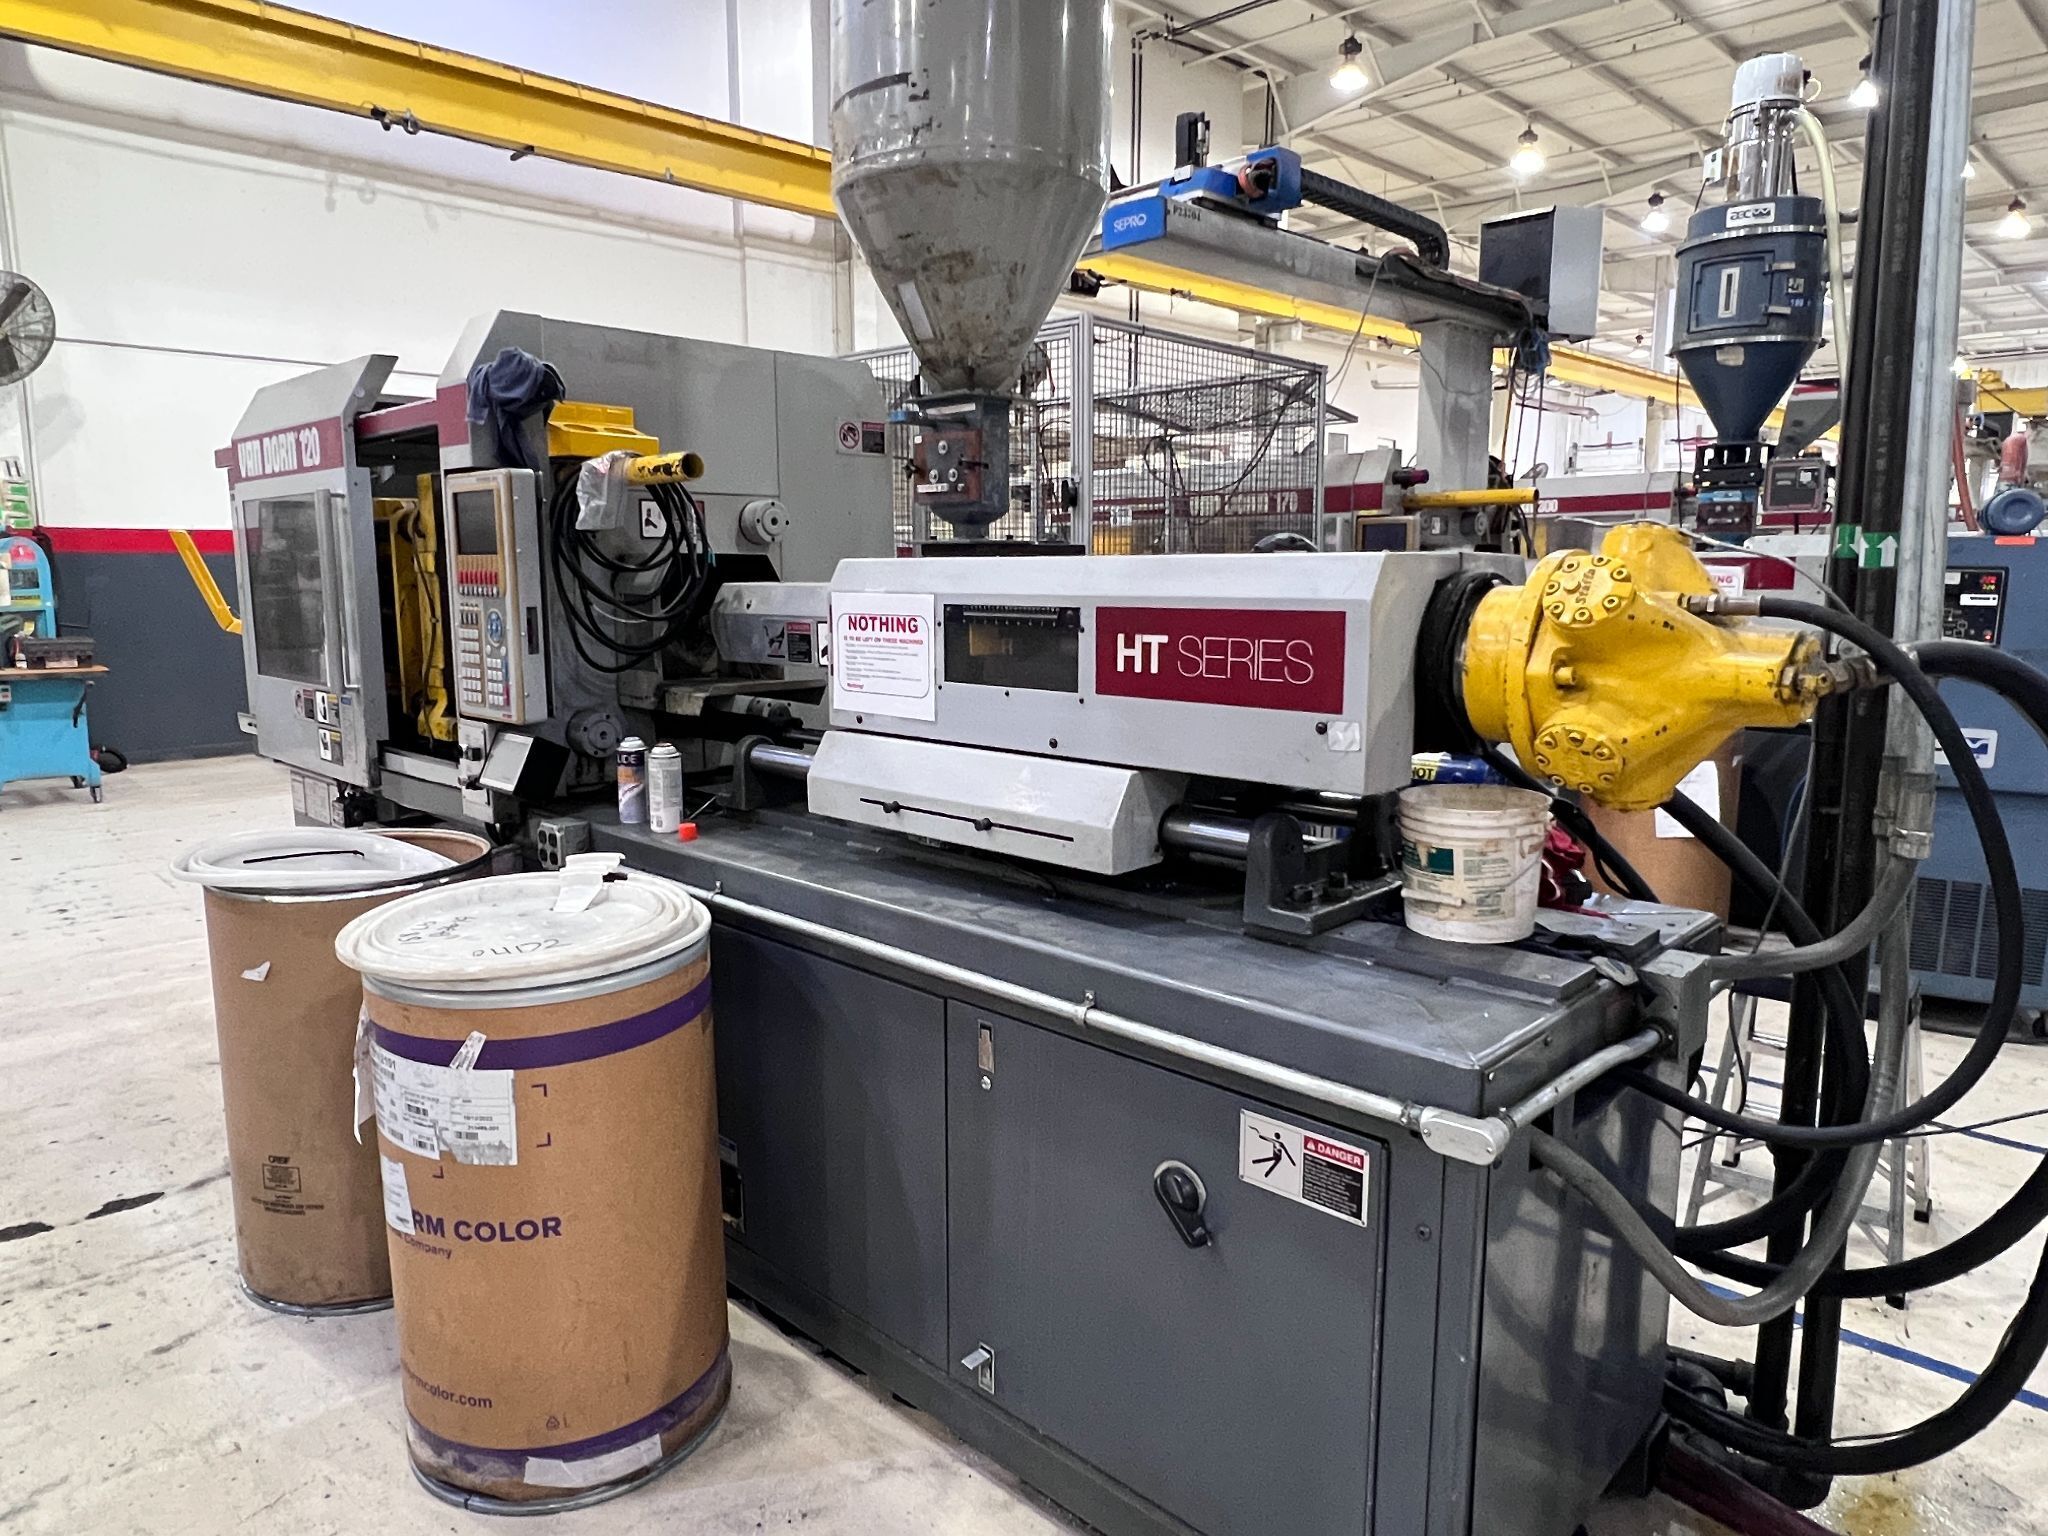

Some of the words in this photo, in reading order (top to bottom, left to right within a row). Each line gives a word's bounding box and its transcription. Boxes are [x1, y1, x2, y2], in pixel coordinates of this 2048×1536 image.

[1113, 213, 1147, 233] SEPRO
[237, 439, 263, 479] VAN
[262, 430, 298, 475] DORN
[298, 426, 320, 468] 120
[1537, 499, 1559, 513] 200
[847, 615, 919, 634] NOTHING
[1116, 633, 1169, 674] HT
[1177, 635, 1314, 685] SERIES
[1317, 1143, 1361, 1167] DANGER
[453, 1216, 562, 1242] COLOR
